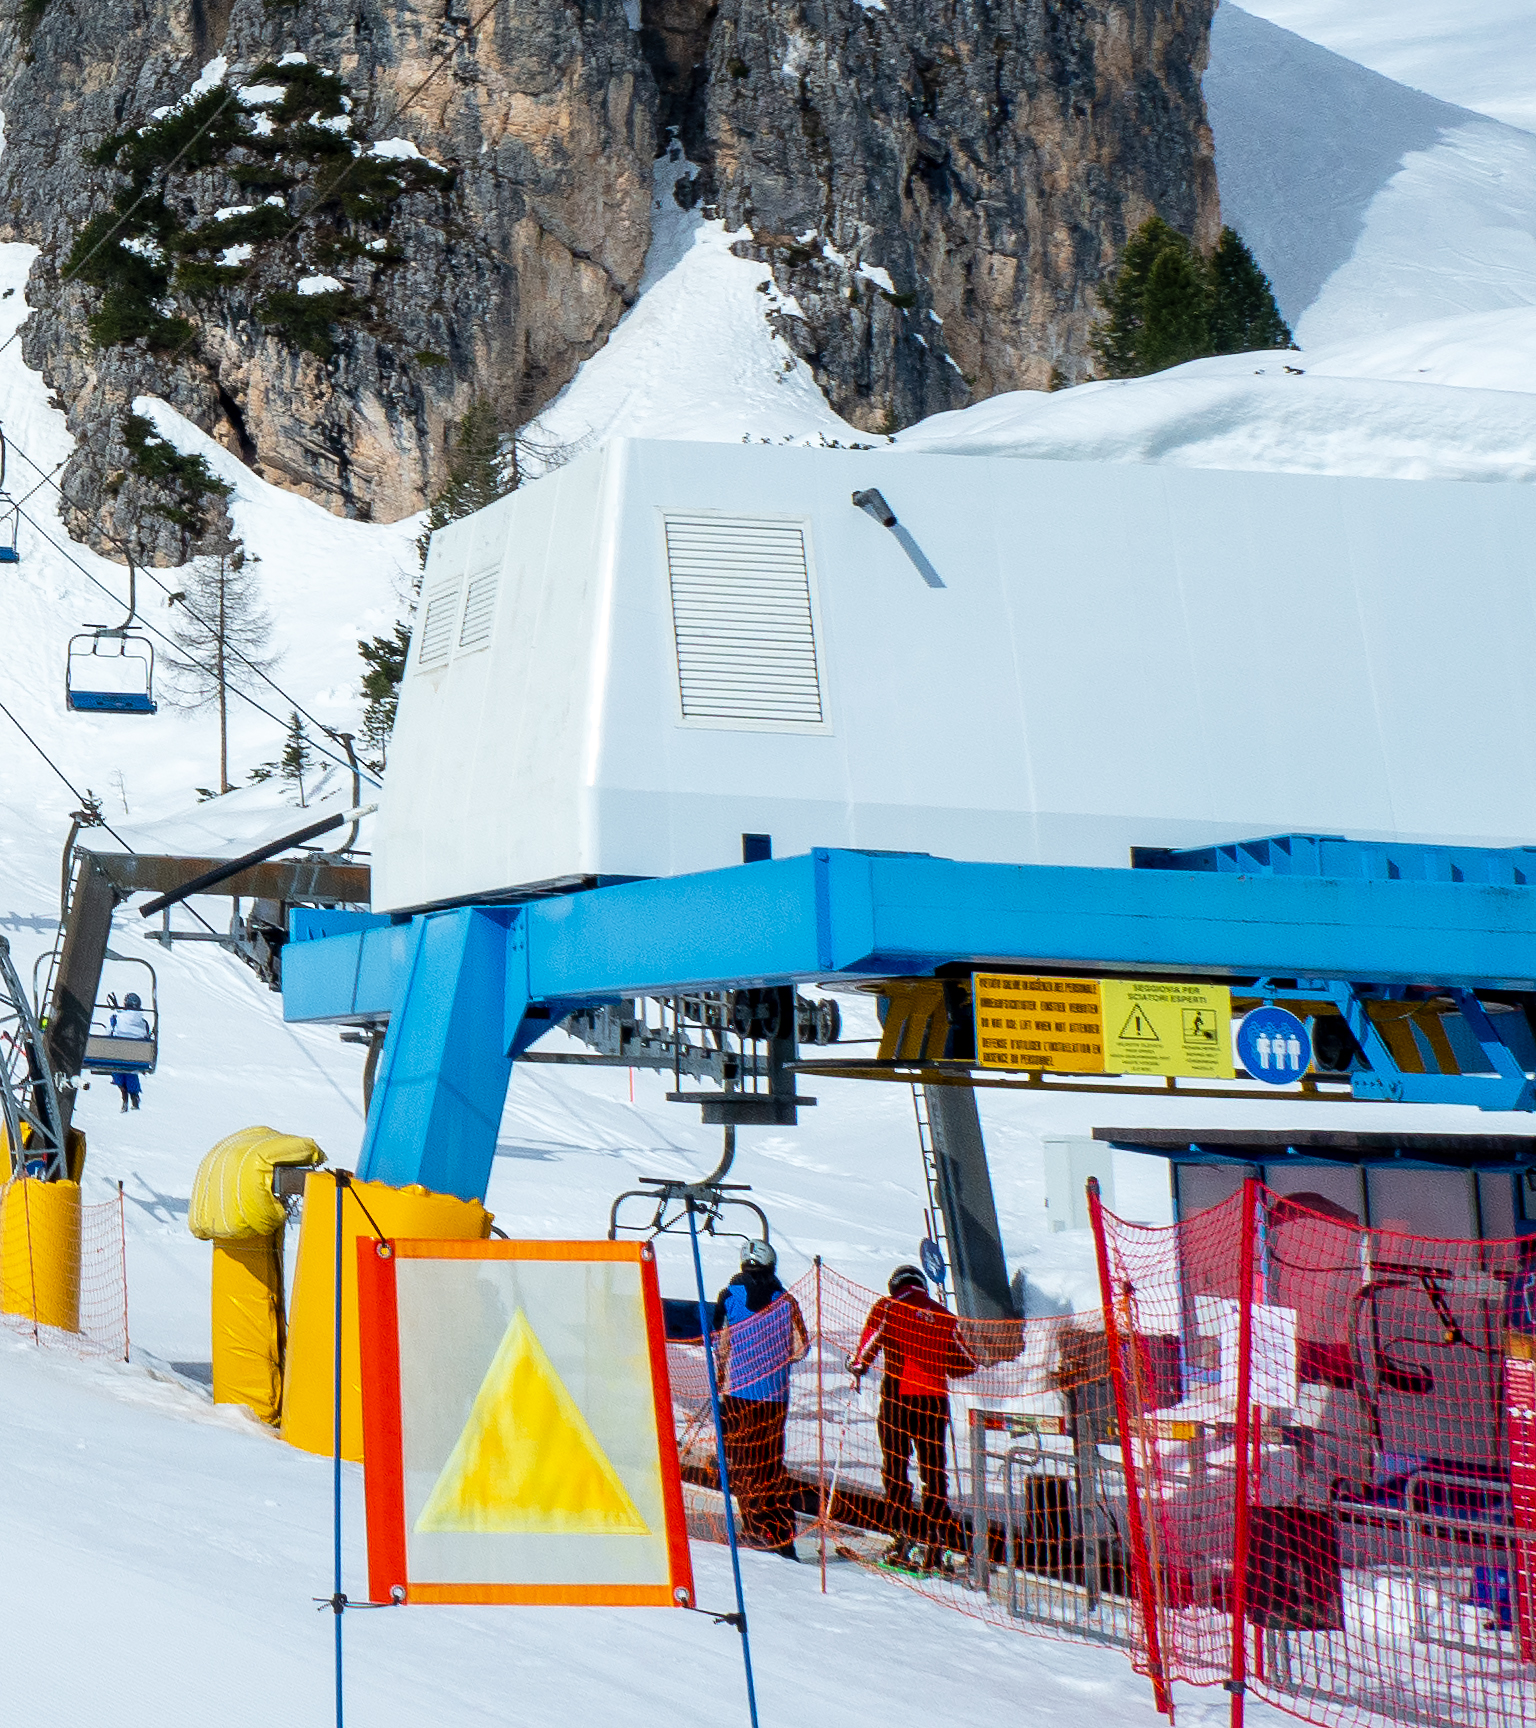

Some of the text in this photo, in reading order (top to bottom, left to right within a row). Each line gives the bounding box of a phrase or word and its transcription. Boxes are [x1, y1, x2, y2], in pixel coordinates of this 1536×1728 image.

[1132, 984, 1180, 993] SEGGIOVIA
[1127, 993, 1168, 1001] SCIATORI
[981, 1018, 1099, 1034] DO NOT USE LIFT WHEN NOT ATTENDED
